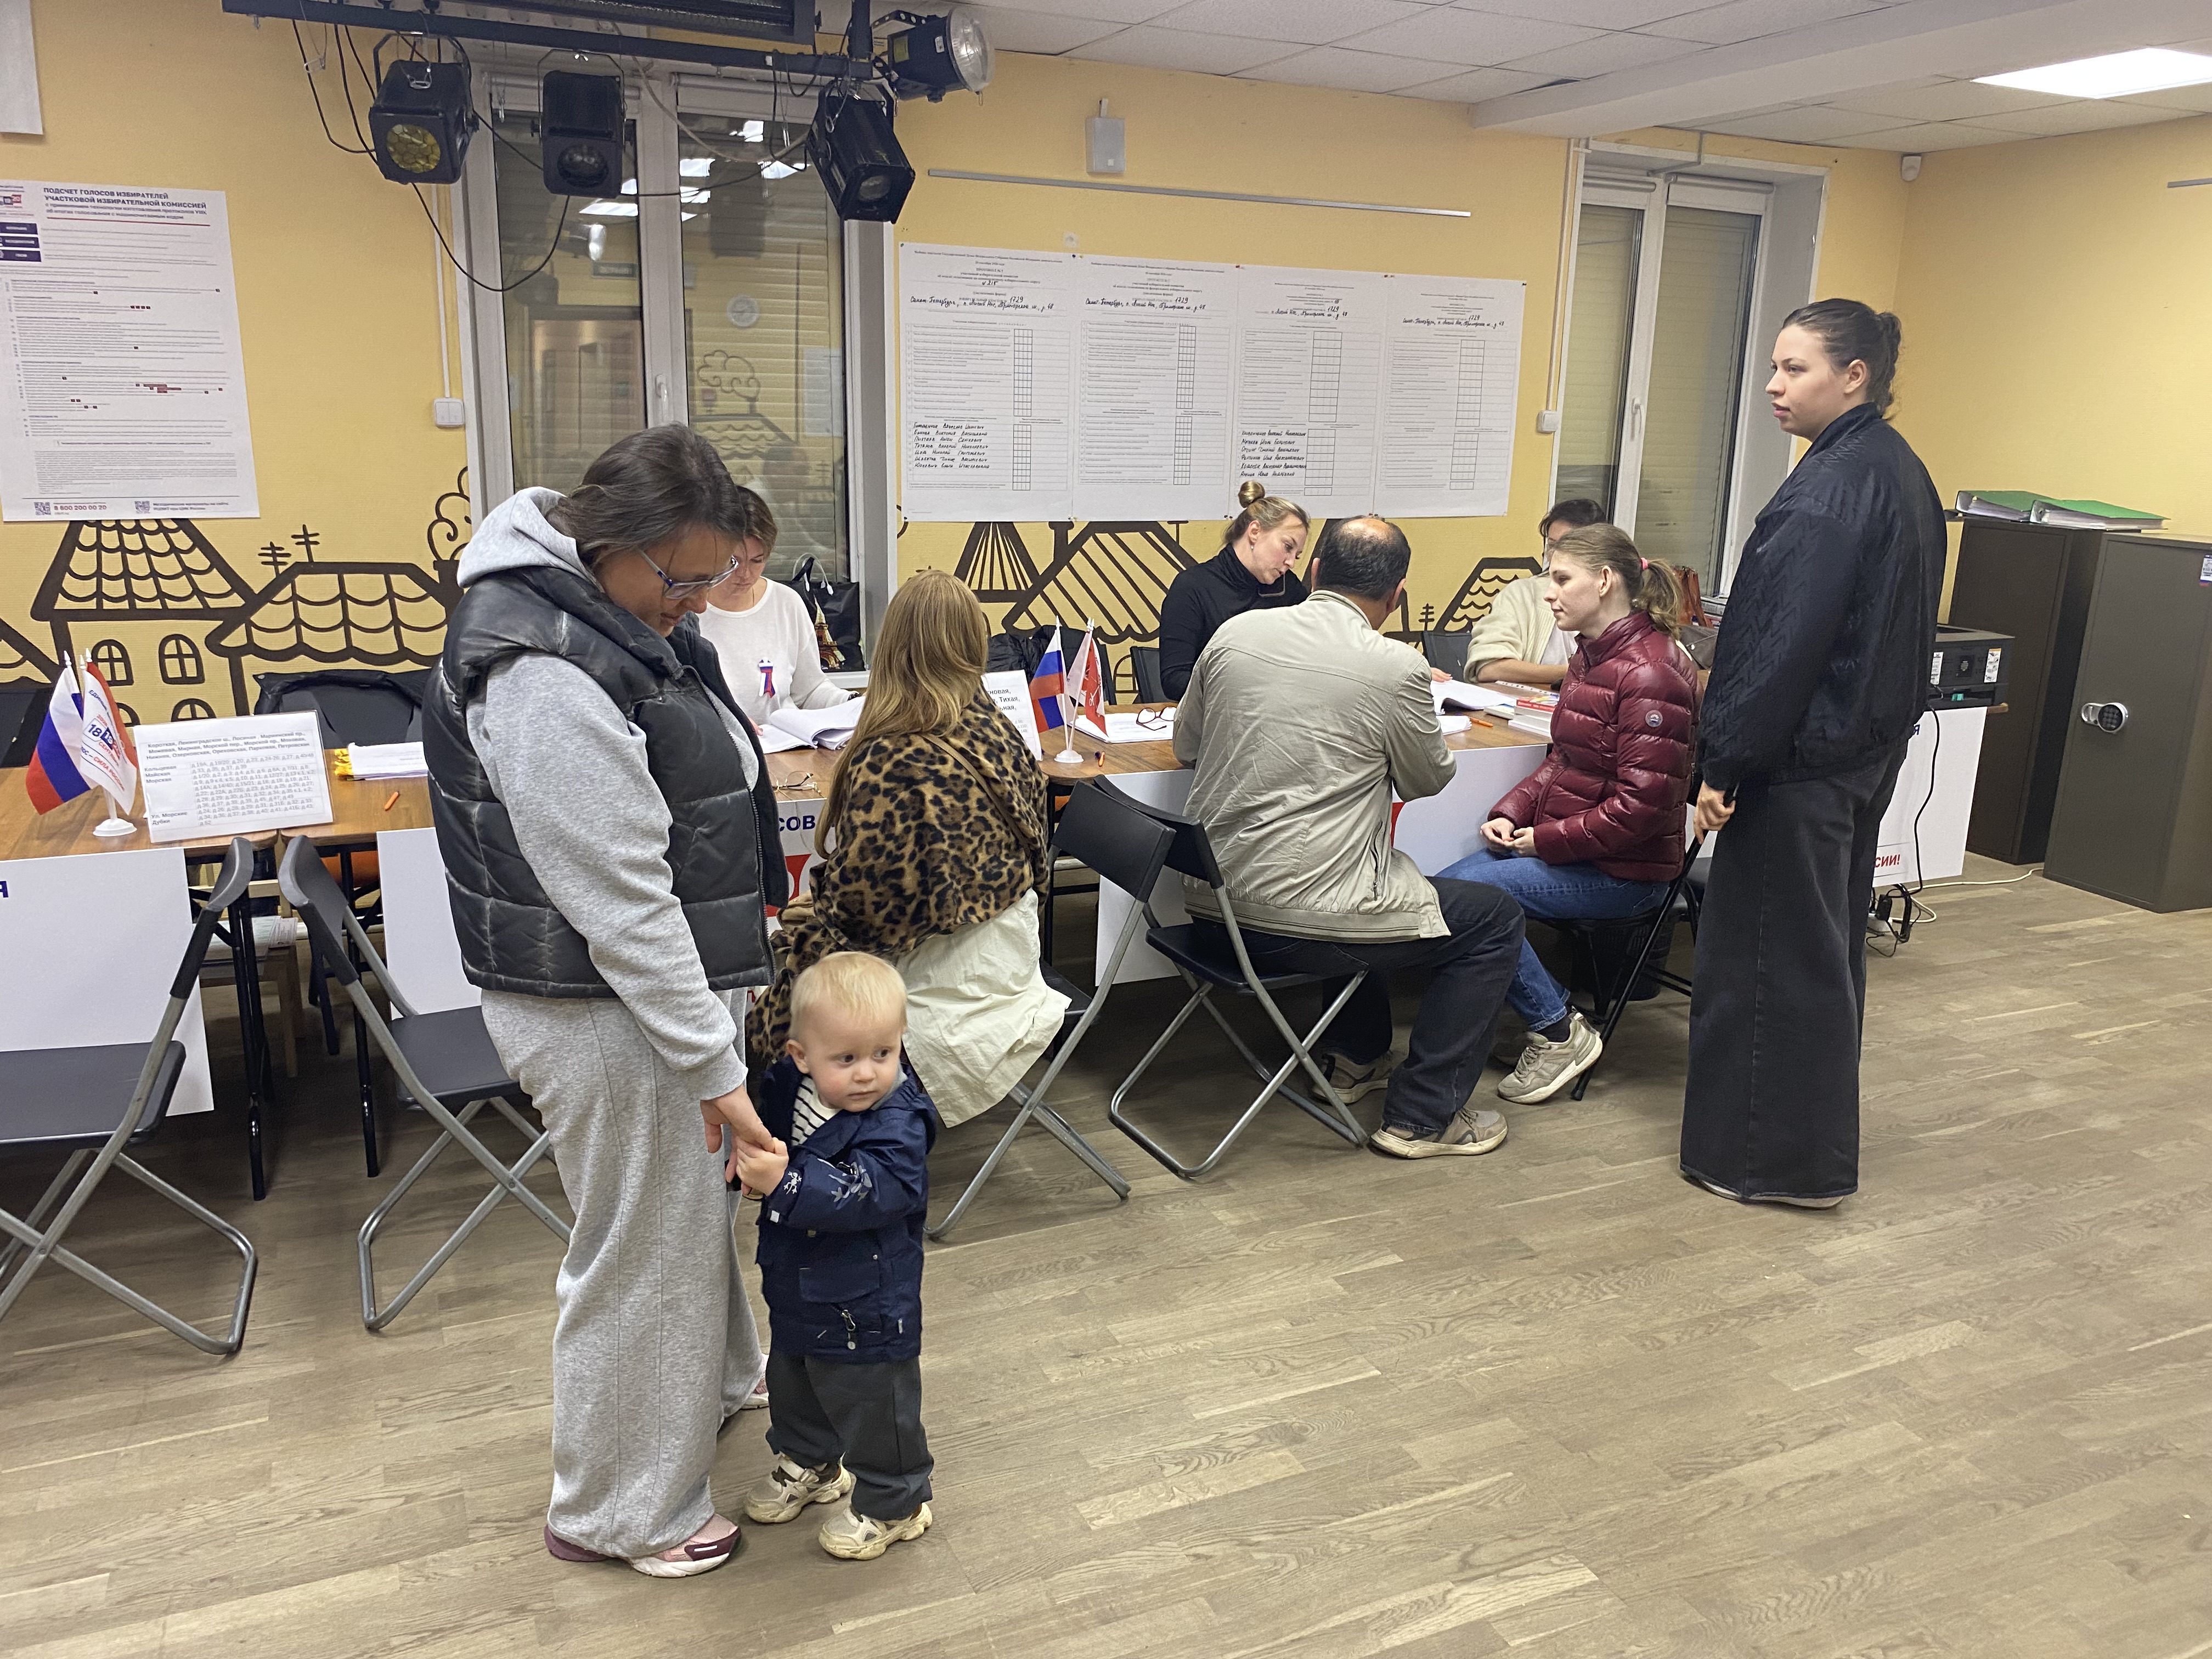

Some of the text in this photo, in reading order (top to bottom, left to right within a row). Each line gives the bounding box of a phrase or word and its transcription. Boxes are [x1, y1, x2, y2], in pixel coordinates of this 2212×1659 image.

[116, 191, 168, 199] ИЗБИРАТЕЛЕЙ
[97, 198, 160, 207] ИЗБИРАТЕЛЬНОЙ
[87, 723, 103, 737] 18
[1874, 854, 1900, 868] СИИ!
